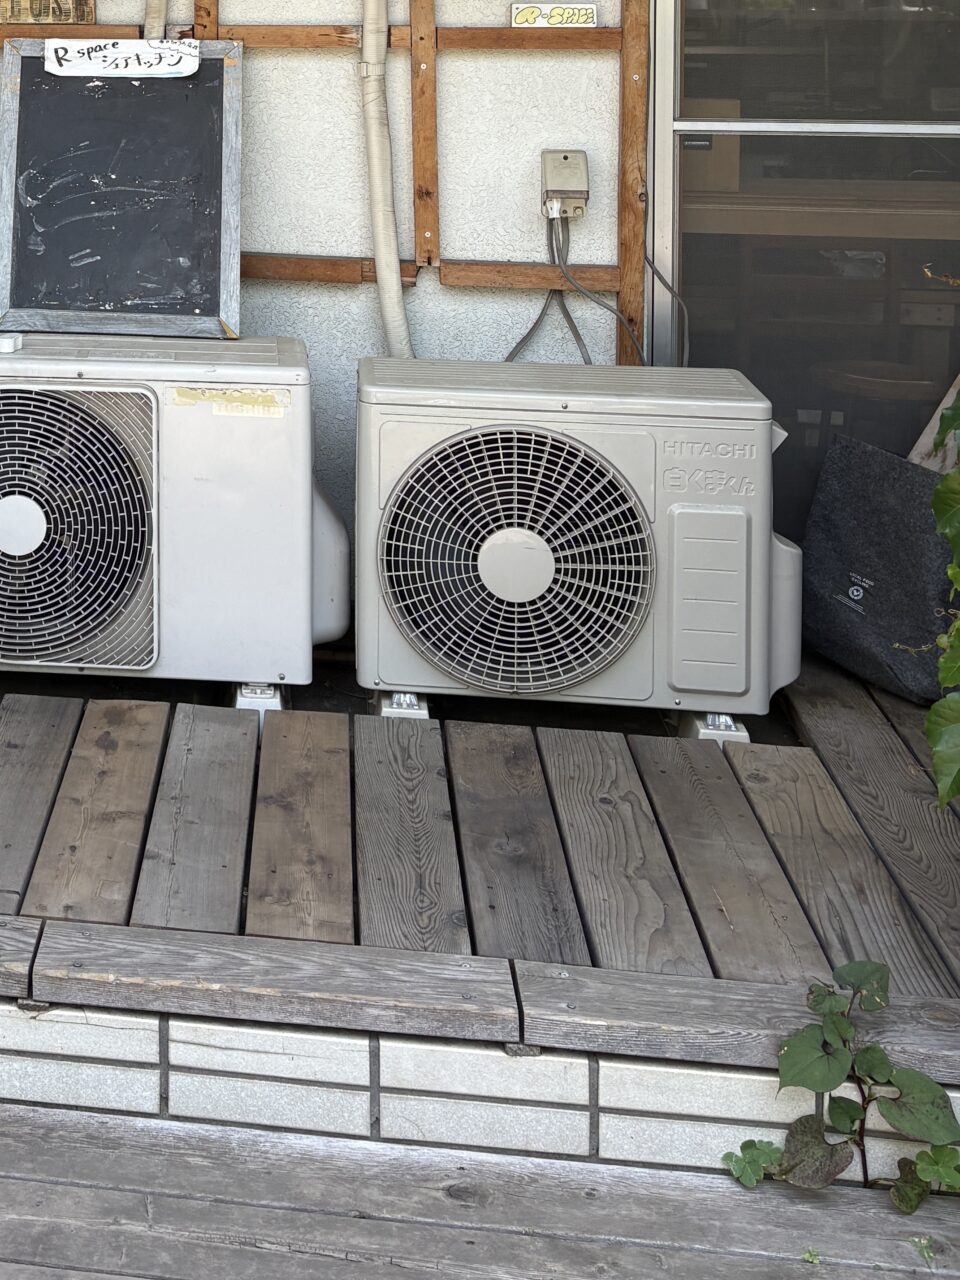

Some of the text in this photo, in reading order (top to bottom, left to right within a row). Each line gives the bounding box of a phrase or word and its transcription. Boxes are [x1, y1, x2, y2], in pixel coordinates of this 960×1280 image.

[53, 40, 120, 68] R space
[663, 440, 757, 460] HITACHI
[663, 466, 756, 497] 白くまくん
